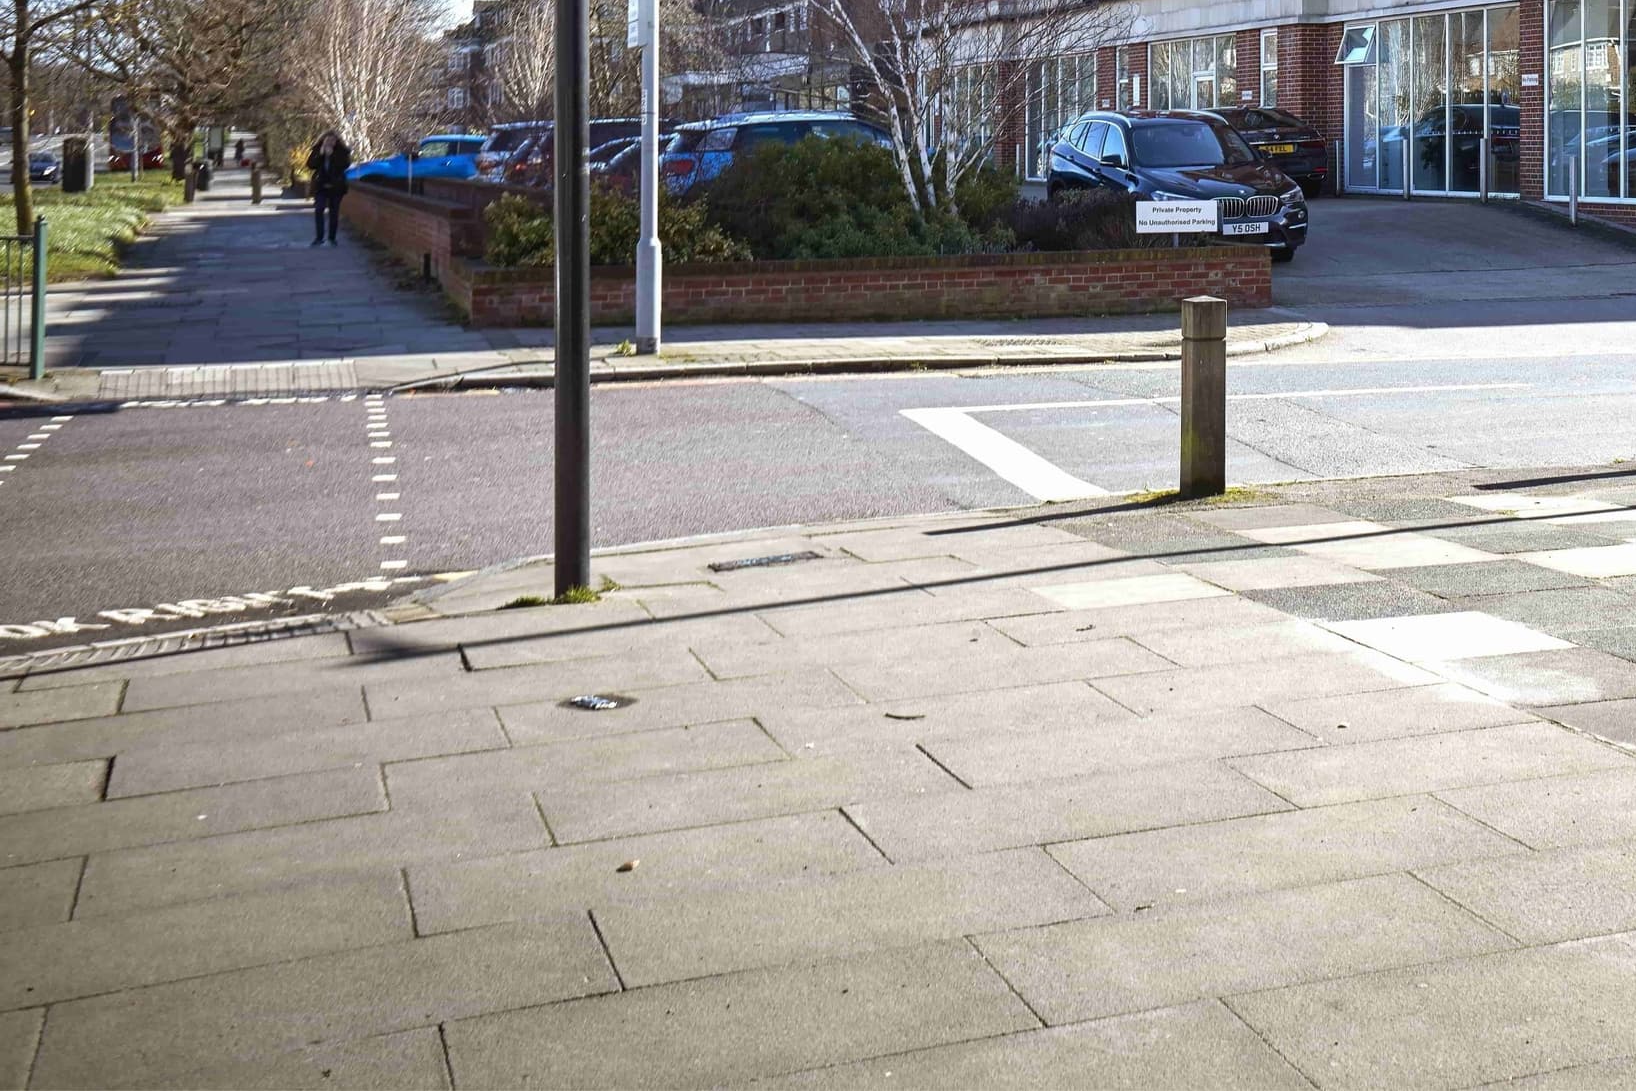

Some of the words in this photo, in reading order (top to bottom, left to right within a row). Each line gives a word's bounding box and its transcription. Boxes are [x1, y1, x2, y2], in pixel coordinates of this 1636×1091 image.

[1175, 206, 1202, 214] Property
[1149, 218, 1191, 226] Unauthorised
[1191, 218, 1216, 226] Parking
[1232, 224, 1243, 233] Y5
